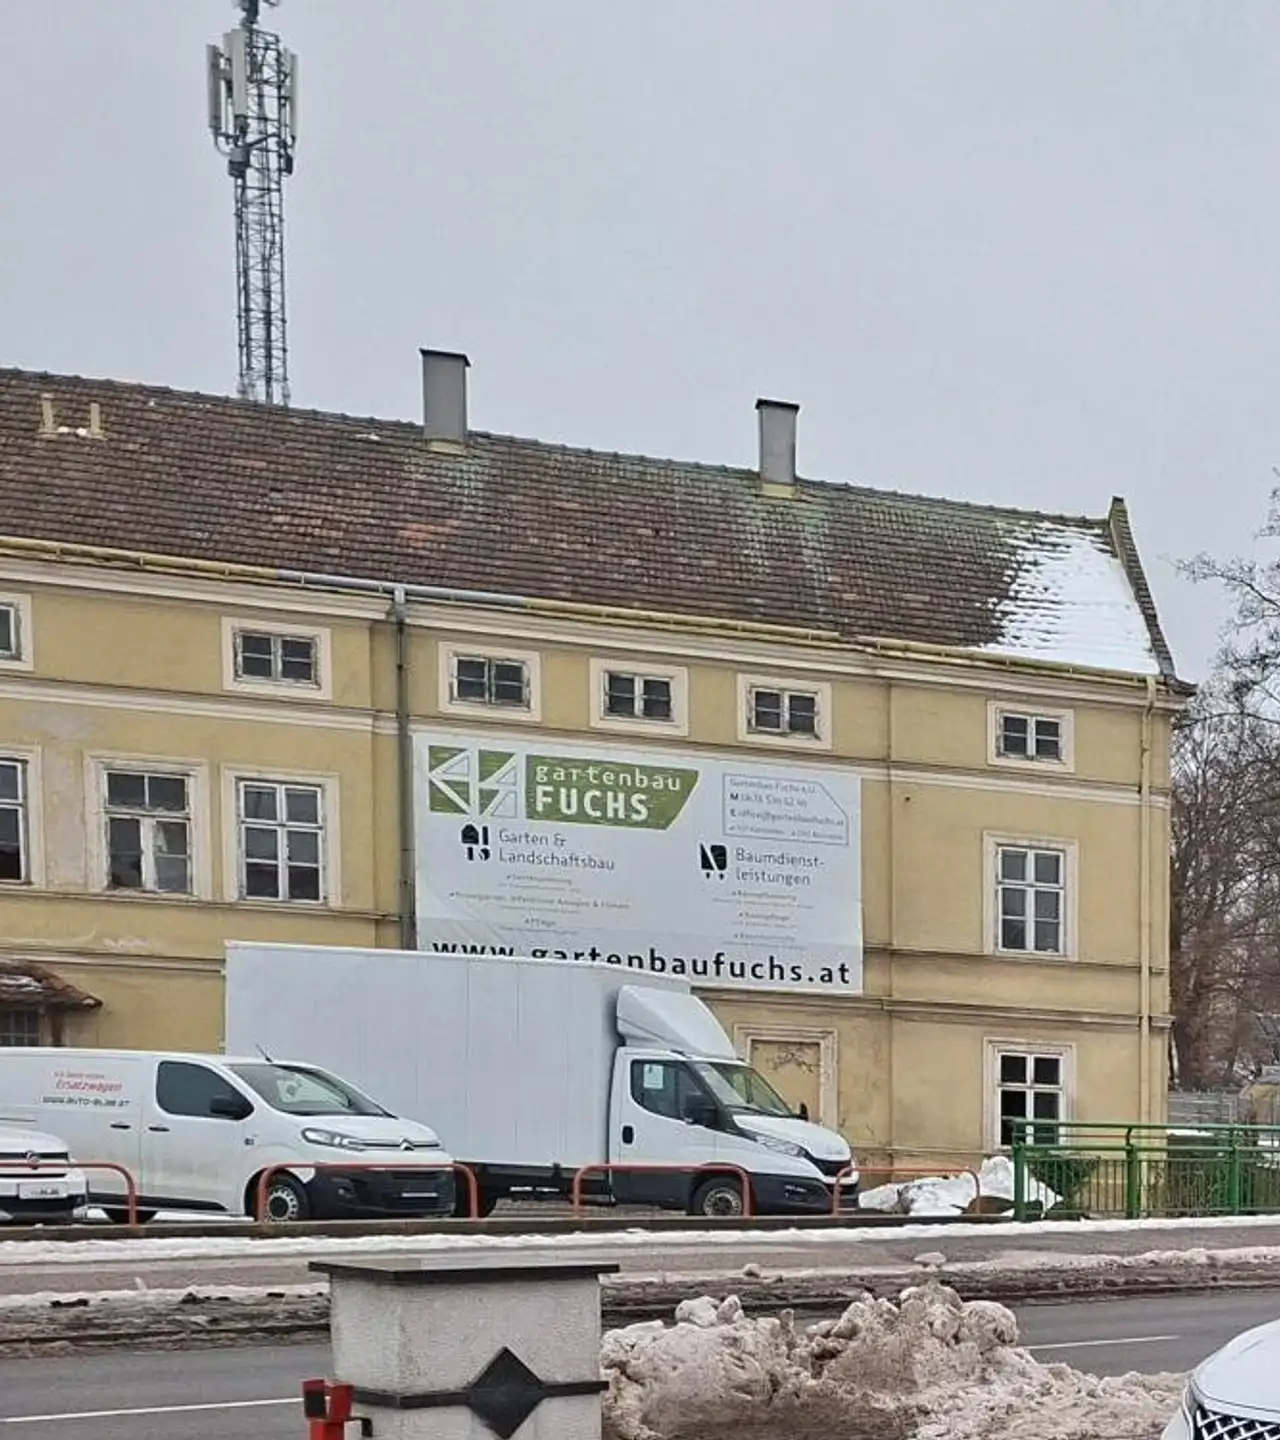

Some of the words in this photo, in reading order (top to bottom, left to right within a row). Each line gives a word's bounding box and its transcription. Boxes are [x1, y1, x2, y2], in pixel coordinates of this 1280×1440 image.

[534, 764, 682, 791] gartenbau
[535, 785, 650, 822] FUCHS
[498, 827, 549, 847] Garten
[498, 848, 616, 871] Landschaftsbau
[735, 847, 826, 869] Baumdienst-
[735, 868, 811, 887] leistungen
